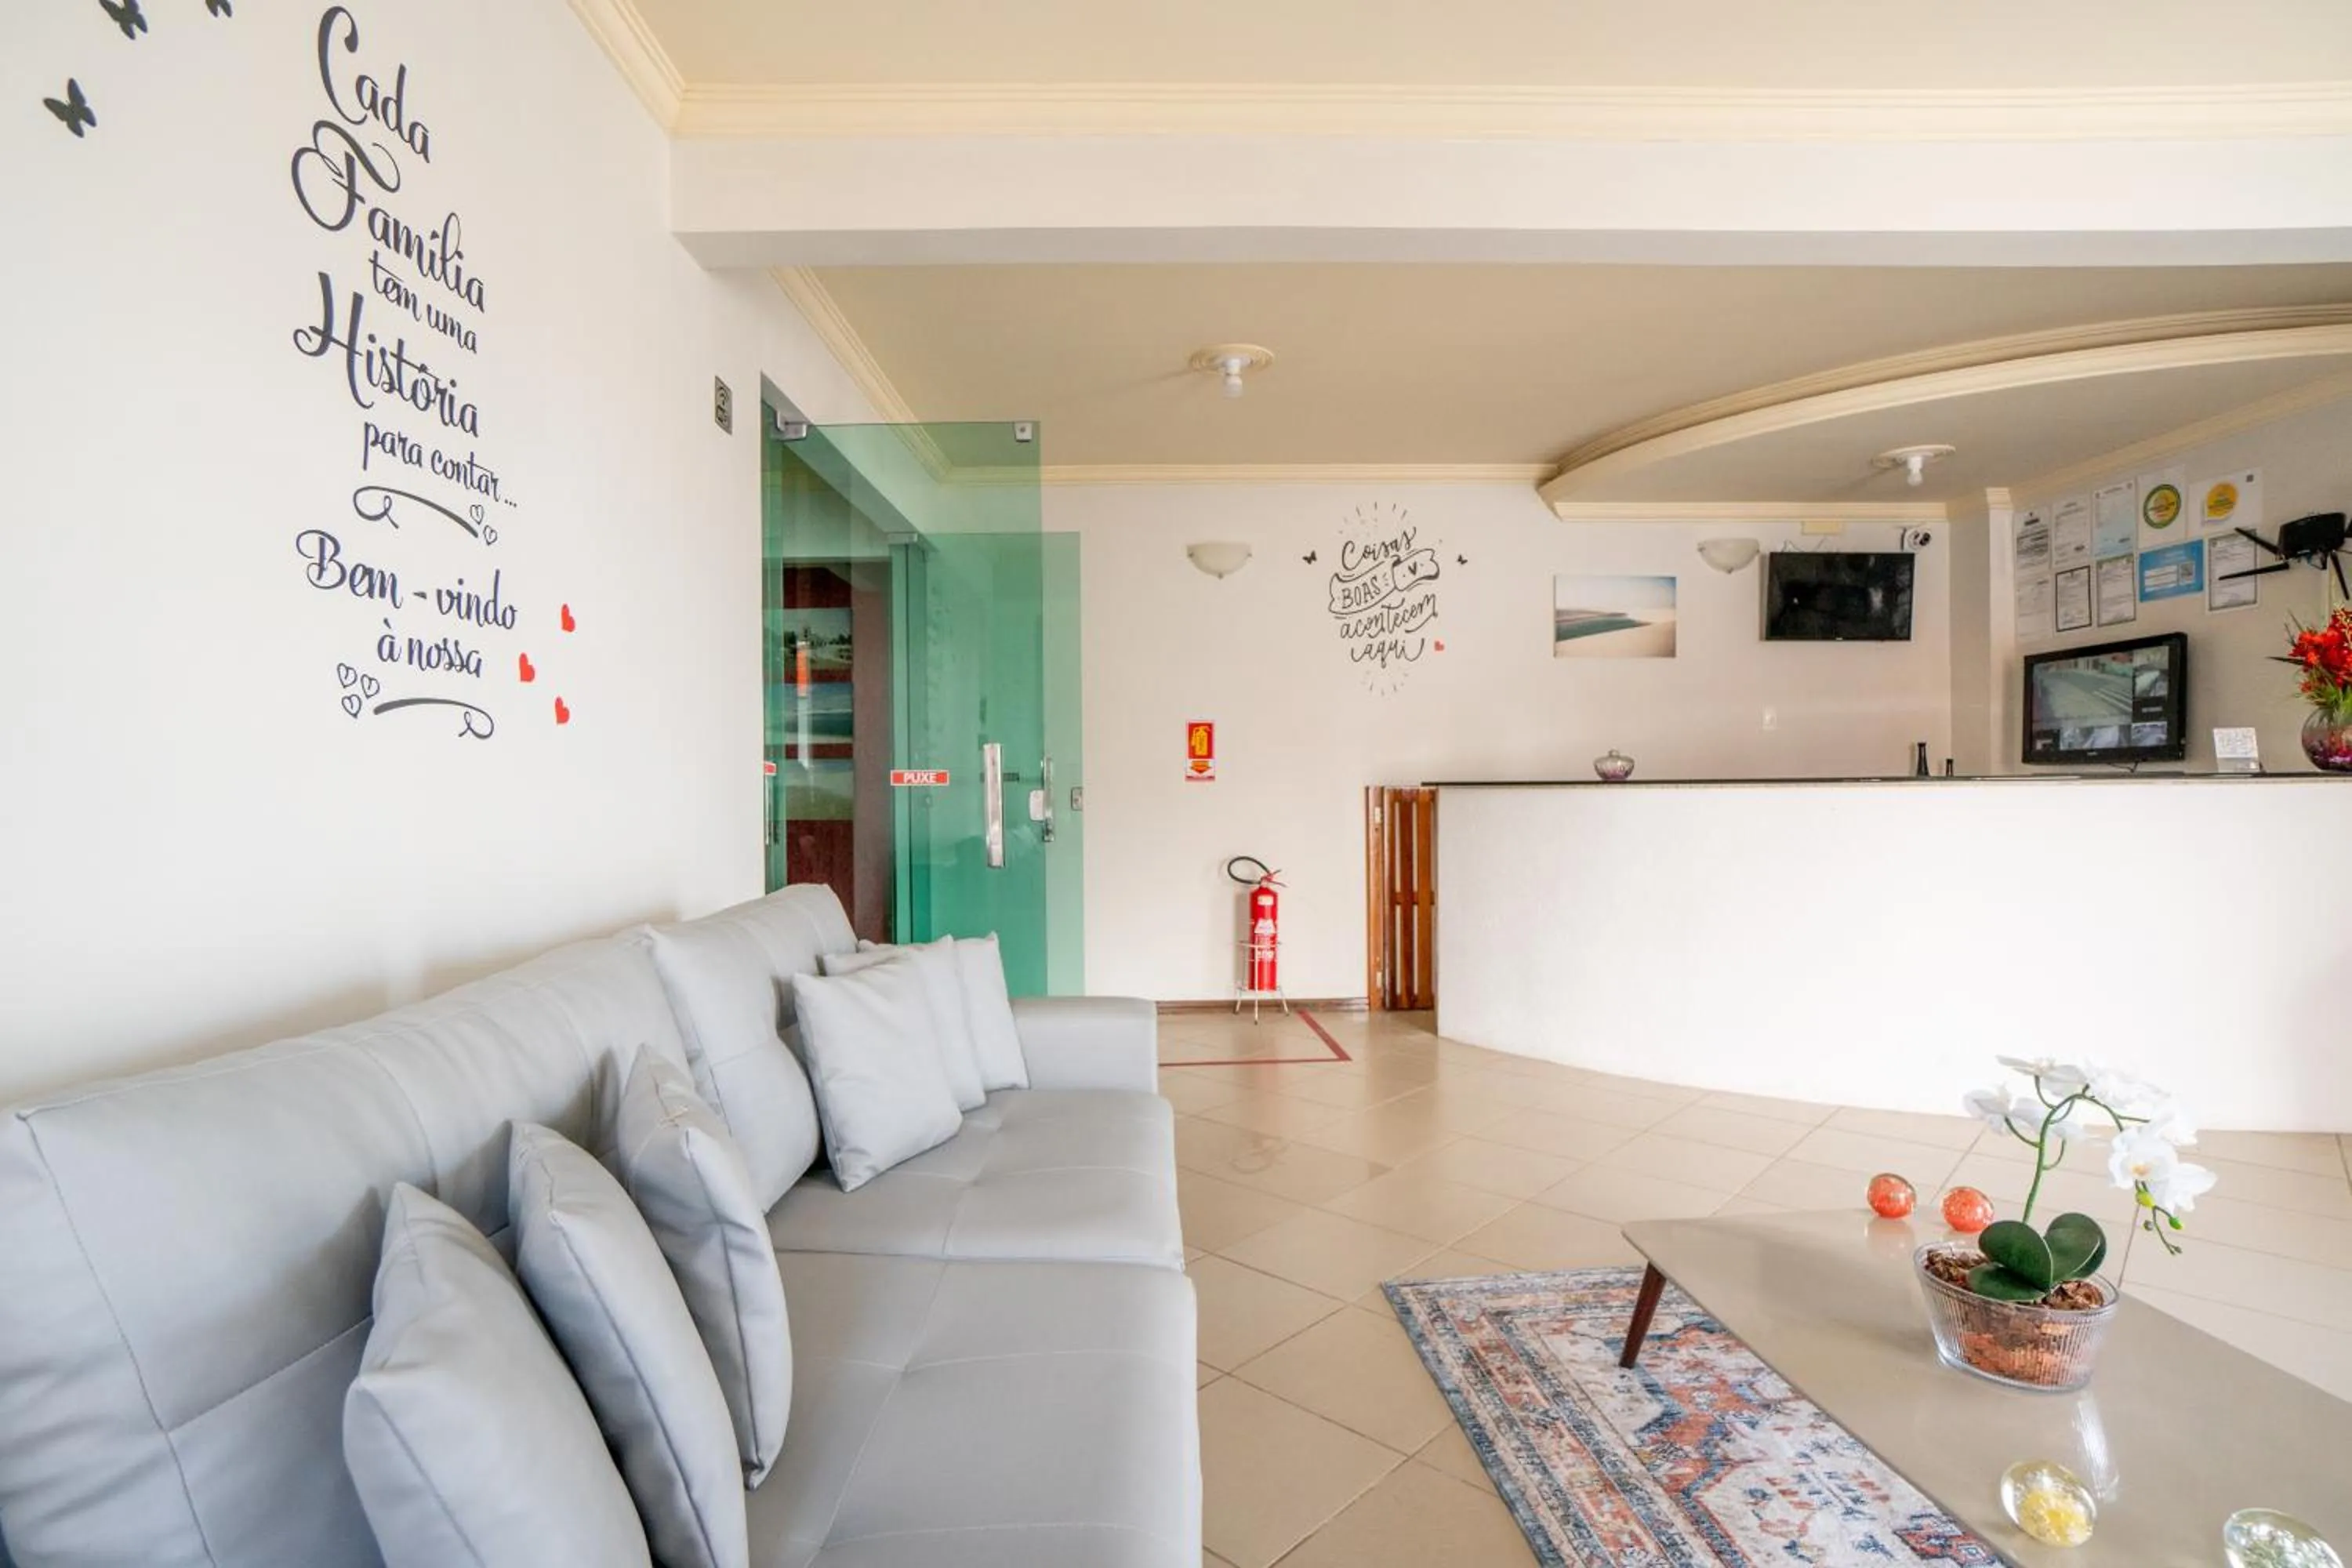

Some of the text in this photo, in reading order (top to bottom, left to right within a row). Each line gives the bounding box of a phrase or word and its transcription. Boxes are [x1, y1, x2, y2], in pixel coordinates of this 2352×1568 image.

[318, 5, 430, 163] Cada
[368, 249, 477, 354] tem uma
[363, 421, 423, 471] para
[1342, 526, 1417, 571] Coisas
[1341, 575, 1381, 609] BOAS
[377, 617, 481, 678] à nossa
[1351, 637, 1425, 669] aqui
[903, 772, 938, 784] PUXE
